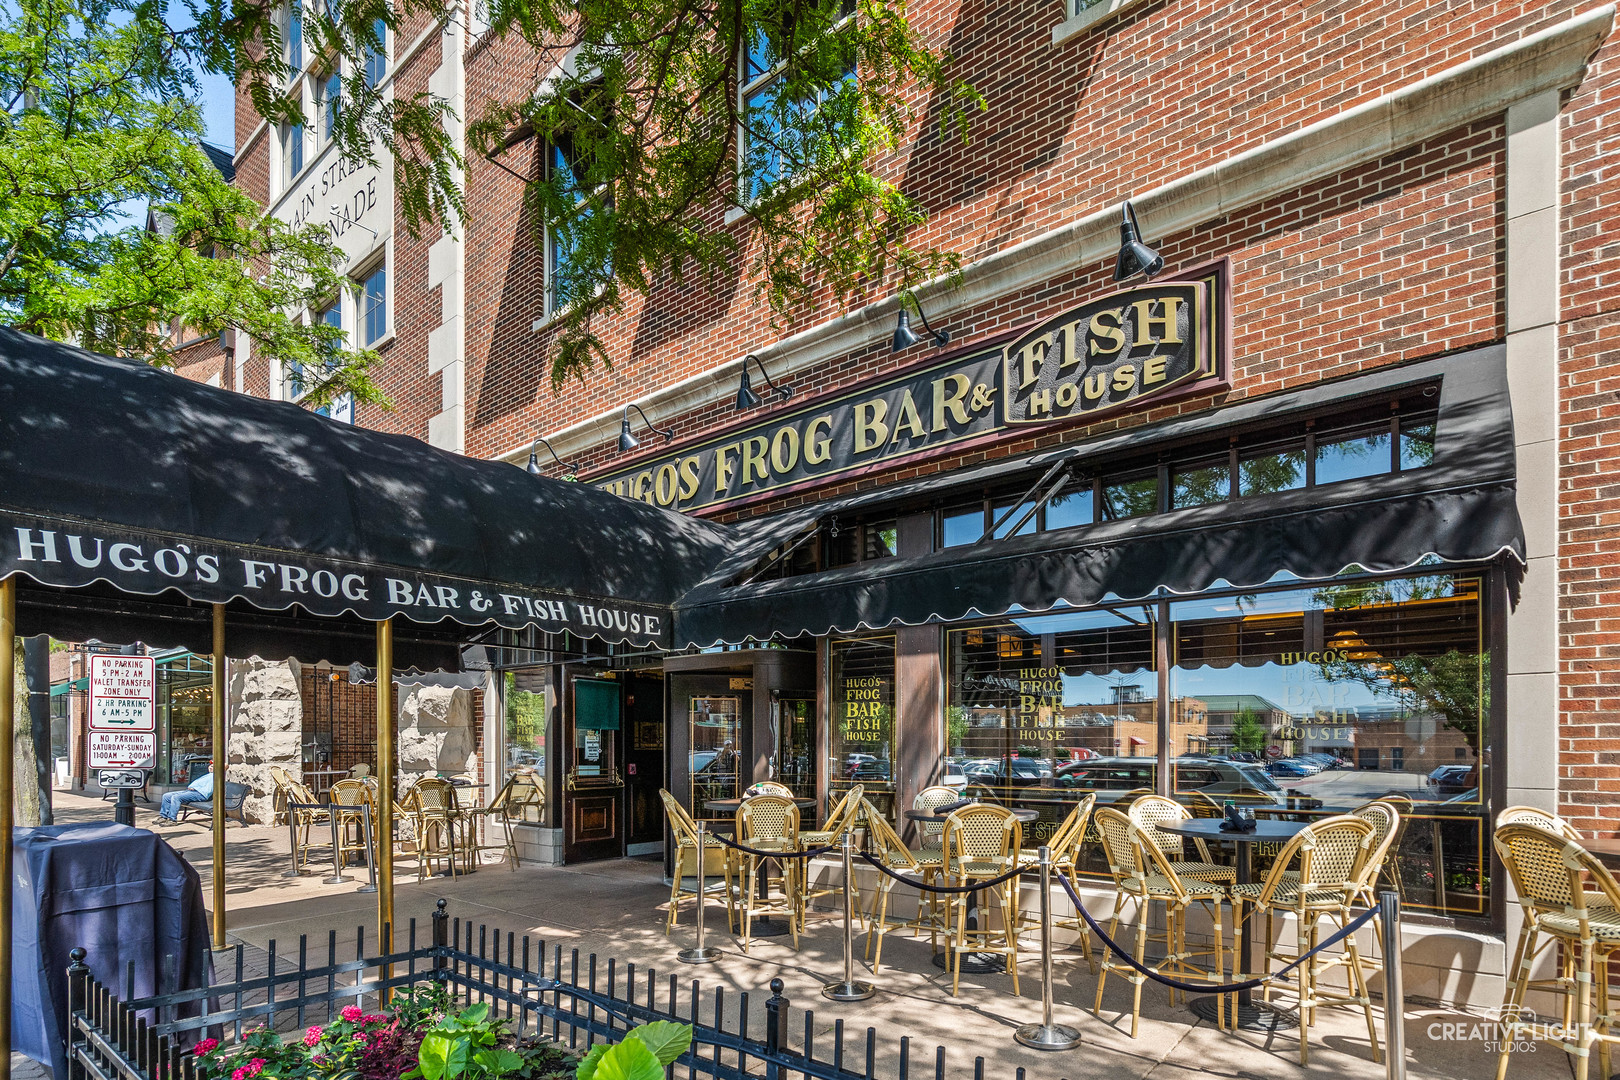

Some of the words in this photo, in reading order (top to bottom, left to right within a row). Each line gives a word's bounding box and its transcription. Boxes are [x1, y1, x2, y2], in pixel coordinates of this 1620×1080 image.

[287, 184, 315, 232] AIN
[322, 148, 370, 197] STREE
[1019, 297, 1184, 391] FISH
[1030, 355, 1167, 416] HOUSE
[601, 456, 700, 507] GO'S
[715, 415, 833, 492] FROG
[853, 373, 972, 454] BAR
[969, 382, 998, 412] &
[13, 527, 221, 584] HUGO'S
[240, 558, 369, 602] FROG
[385, 577, 461, 609] BAR
[469, 590, 493, 612] &
[498, 593, 570, 622] FISH
[577, 604, 662, 636] HOUSE
[1280, 647, 1349, 665] HUGO'S
[102, 660, 111, 668] NO
[115, 660, 144, 669] PARKING
[133, 670, 143, 678] AM
[1019, 665, 1067, 679] HUGO'S
[94, 678, 113, 686] VALET
[117, 679, 151, 687] TRANSFER
[846, 675, 881, 688] HUGO'S
[1019, 680, 1064, 693] FROG
[103, 688, 121, 696] ZONE
[125, 688, 142, 696] ONLY
[846, 689, 881, 701] FROG
[97, 699, 102, 707] 2
[105, 699, 115, 707] HR
[118, 700, 147, 708] PARKING
[846, 701, 881, 718] BAR
[1019, 695, 1065, 714] BAR
[102, 708, 106, 716] 6
[133, 709, 143, 717] PM
[1300, 709, 1348, 725] ISH
[516, 714, 534, 726] BAR
[846, 719, 881, 730] FISH
[115, 735, 145, 743] PARKING
[846, 731, 881, 742] HOUSE
[1019, 730, 1066, 741] HOUSE
[1280, 727, 1348, 741] HOUSE
[1035, 822, 1102, 843] STKS
